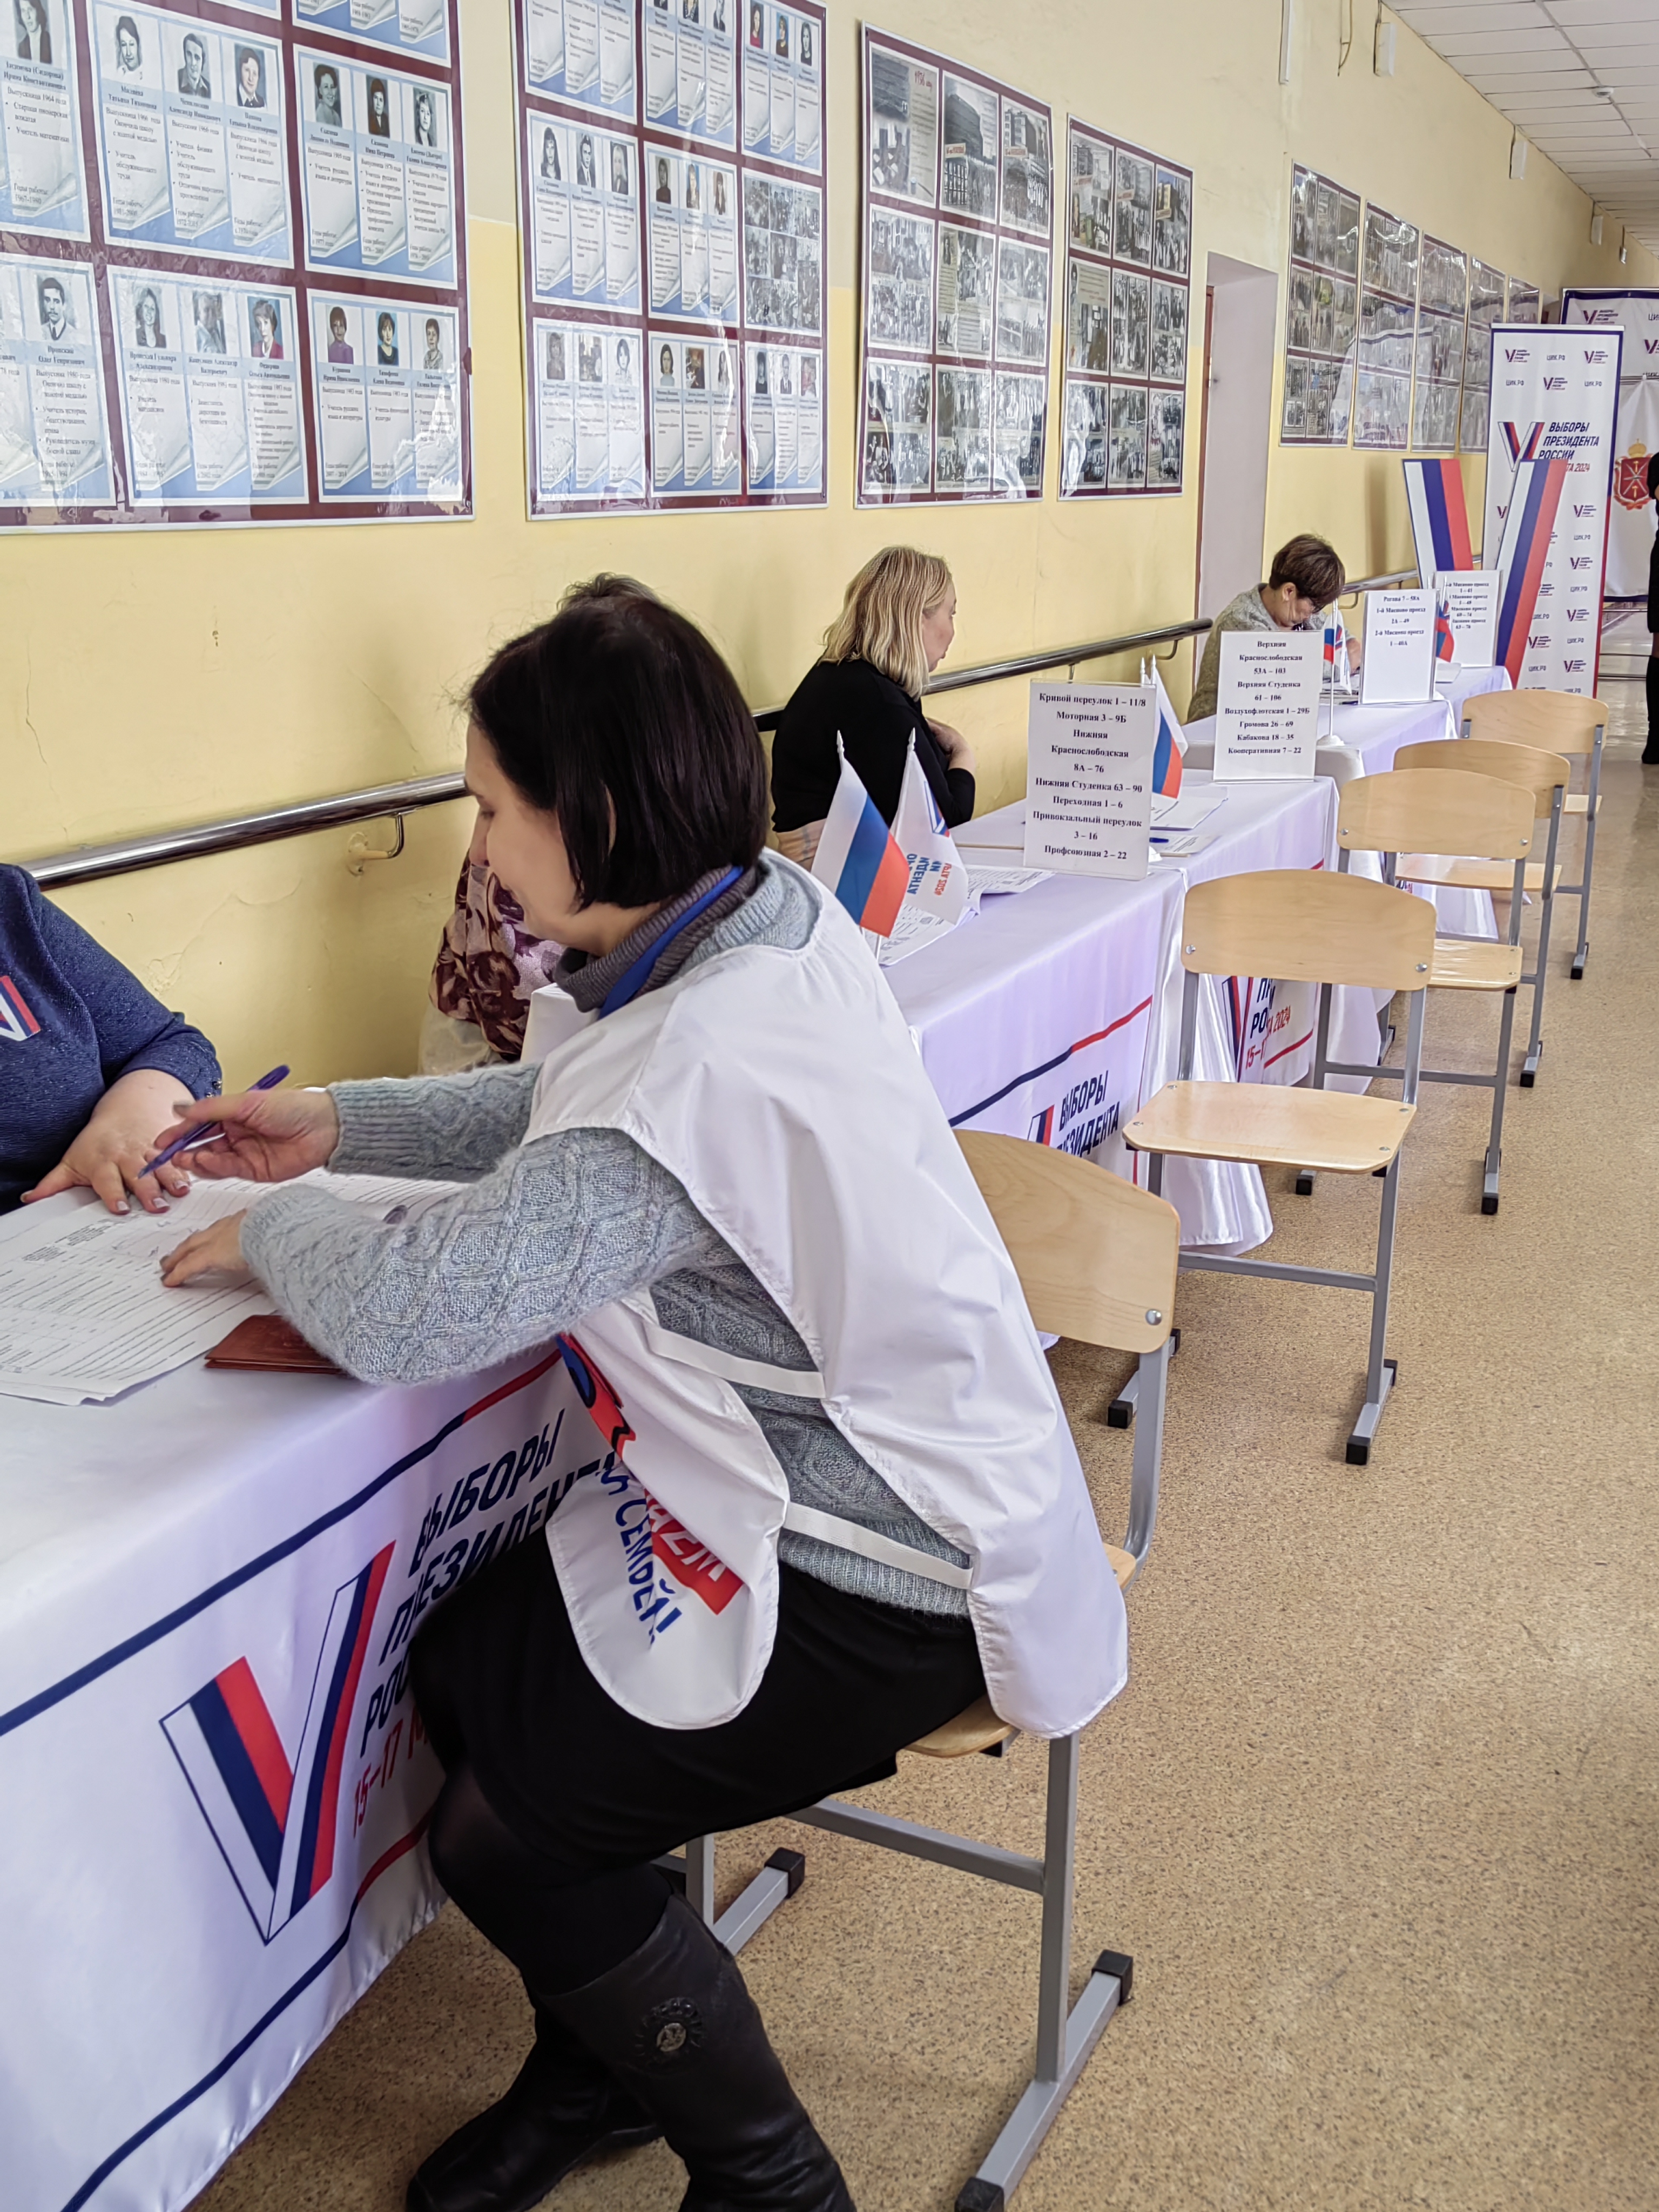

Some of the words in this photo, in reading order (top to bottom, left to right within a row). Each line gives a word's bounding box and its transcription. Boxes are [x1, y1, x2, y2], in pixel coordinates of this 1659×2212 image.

[1549, 422, 1590, 432] ВЫБОРЫ
[1543, 436, 1600, 447] ПРЕЗИДЕНТА
[1538, 450, 1575, 460] РОССИИ
[1574, 463, 1590, 472] 2024
[1040, 693, 1071, 703] Кривой
[1074, 696, 1112, 705] переулок
[1129, 698, 1146, 706] 11/8
[1057, 712, 1099, 721] Моторная
[1115, 715, 1126, 723] 9Б
[1073, 730, 1108, 739] Нижняя
[1051, 745, 1129, 757] Краснослободская
[1074, 764, 1085, 772] 8А
[1035, 778, 1069, 788] Нижняя
[1071, 780, 1112, 792] Студенка
[1114, 784, 1123, 792] 63
[1132, 785, 1142, 793] 90
[1053, 795, 1102, 807] Переходная
[1033, 811, 1101, 824] Привокзальный
[1103, 817, 1142, 827] переулок
[1074, 831, 1079, 839] 3
[1089, 832, 1098, 840] 16
[1044, 845, 1101, 858] Профсоюзная
[1117, 852, 1127, 860] 22
[408, 1408, 565, 1578] ВЫБОРЫ
